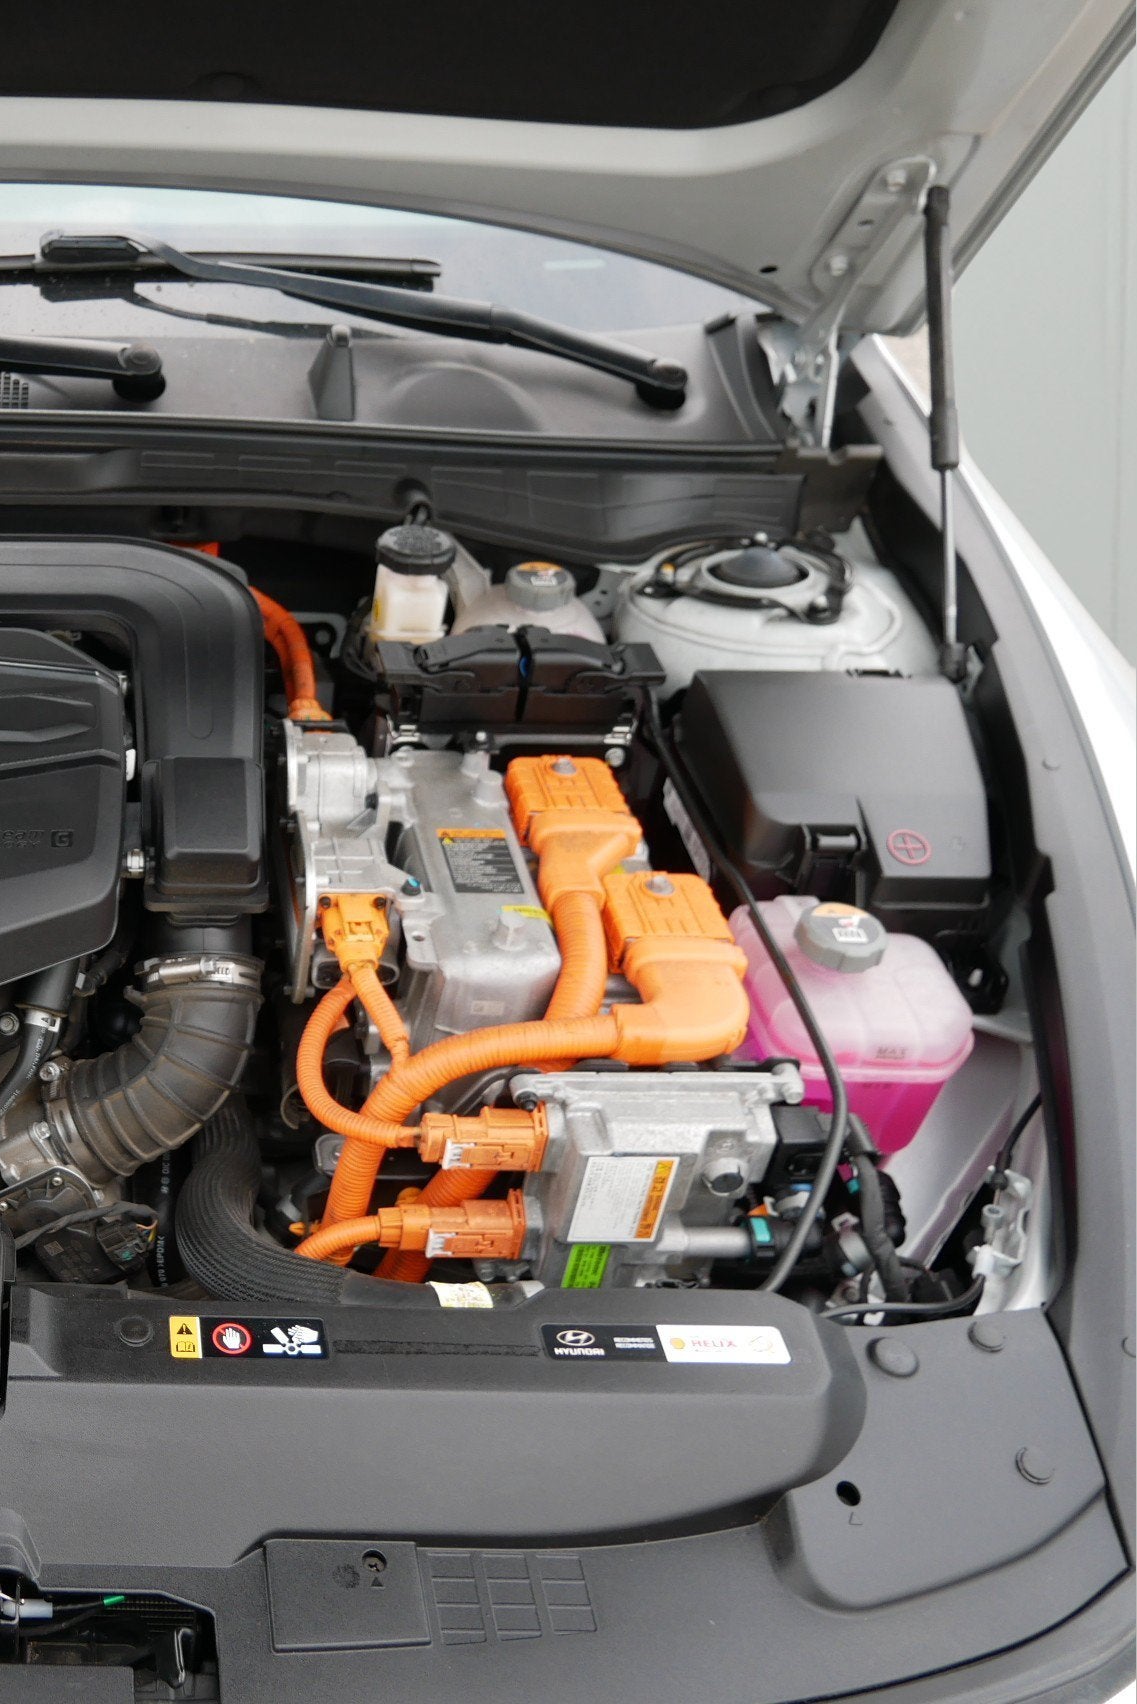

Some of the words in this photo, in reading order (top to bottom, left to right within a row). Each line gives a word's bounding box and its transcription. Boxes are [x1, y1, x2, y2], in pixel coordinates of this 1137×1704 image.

[52, 830, 72, 848] G
[691, 1340, 737, 1348] HELIX
[554, 1347, 605, 1356] HYUNDAI
